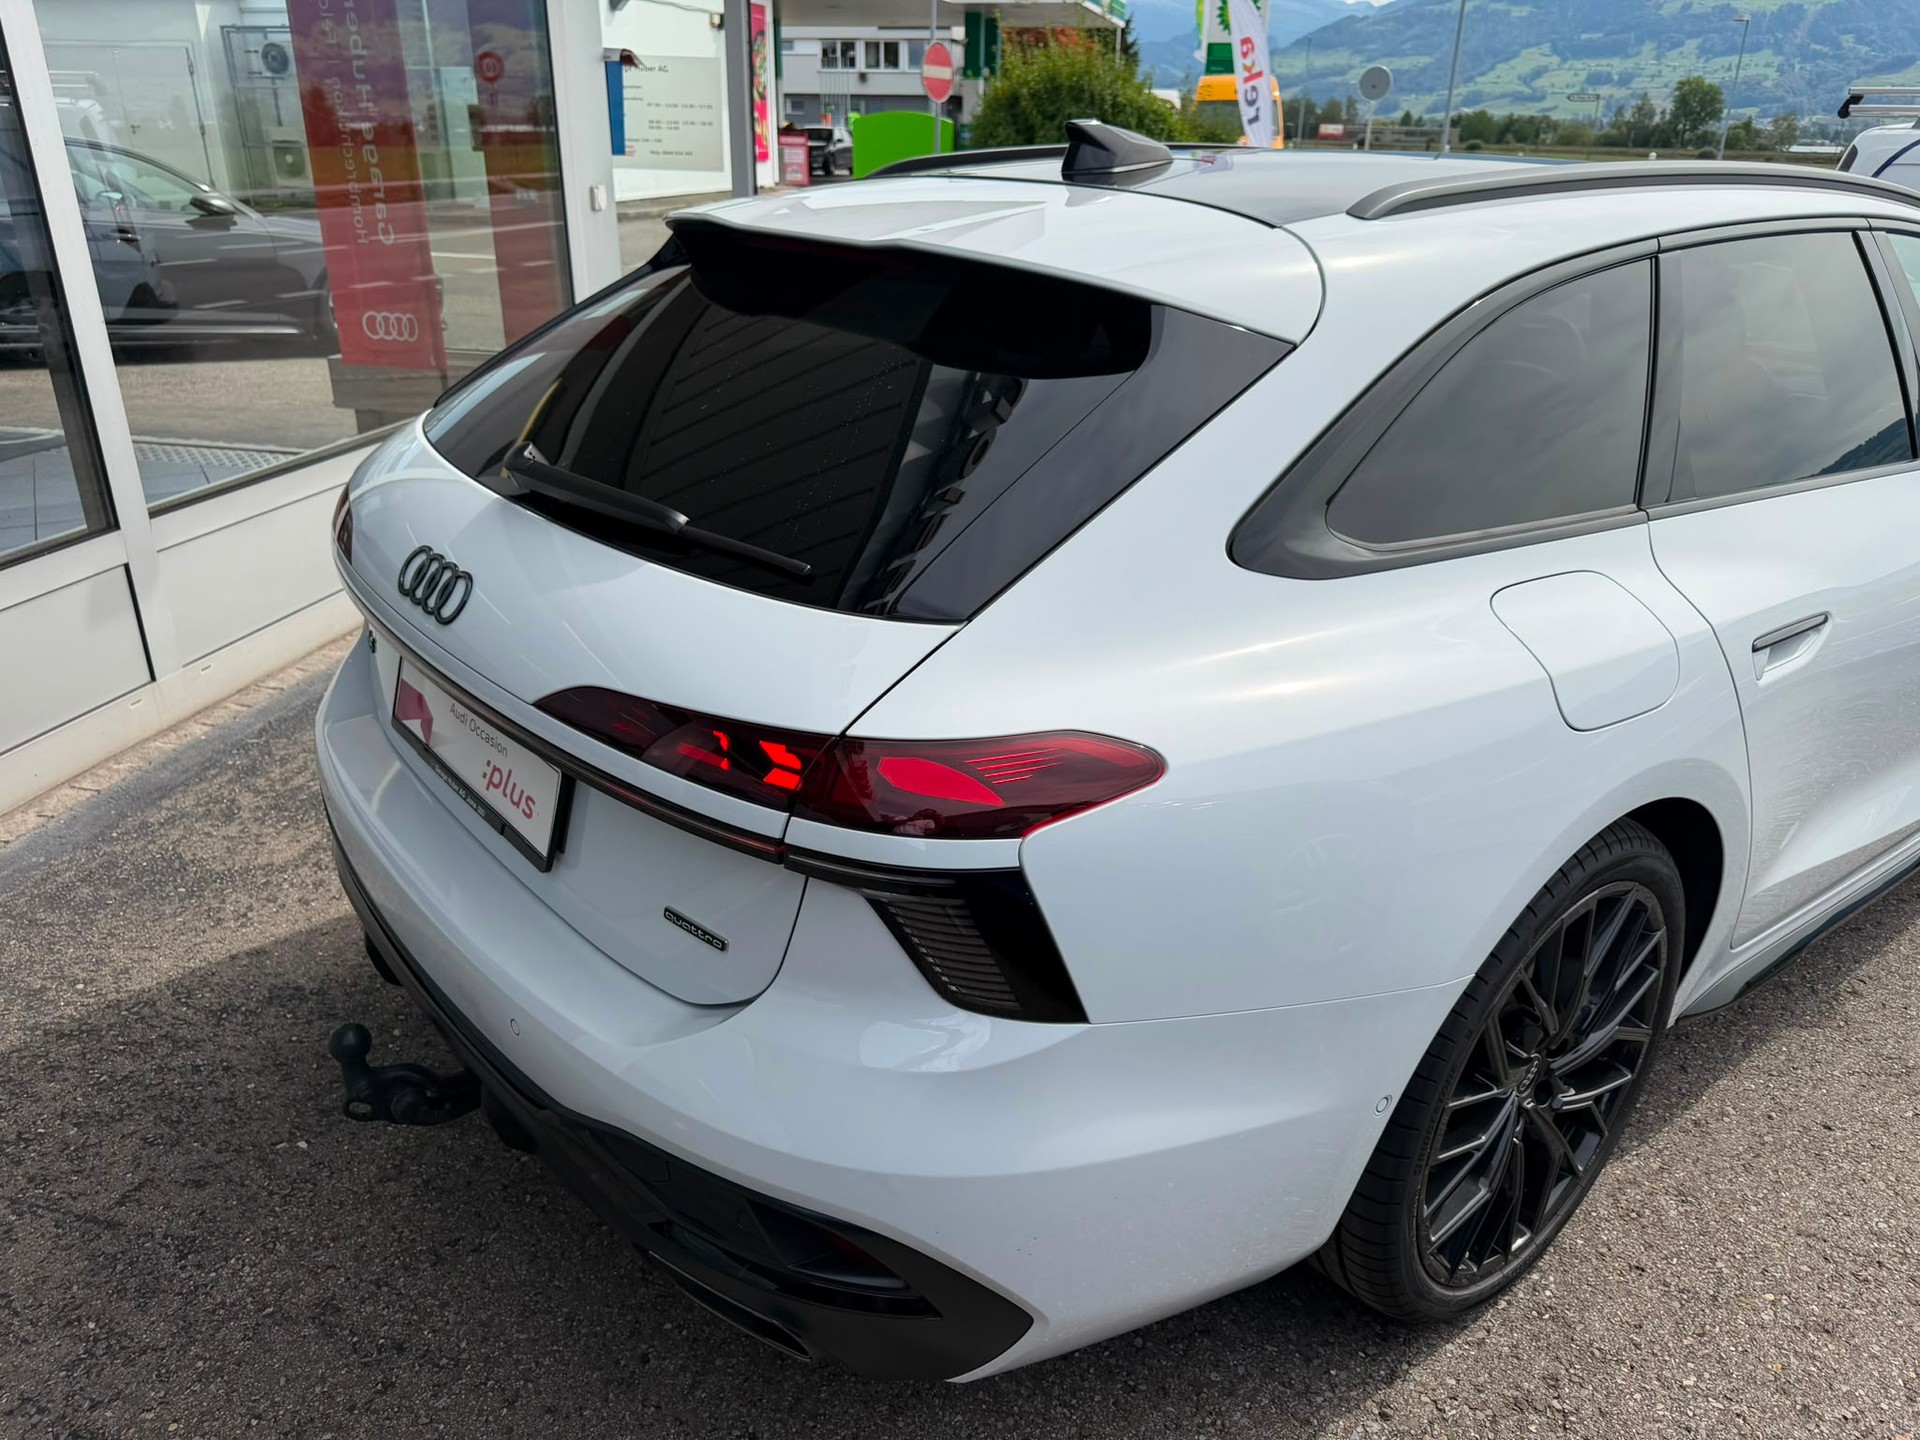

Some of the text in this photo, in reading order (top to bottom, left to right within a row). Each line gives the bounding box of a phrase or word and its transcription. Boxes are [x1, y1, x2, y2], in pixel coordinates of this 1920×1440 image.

[450, 703, 509, 759] Audi Occasion
[665, 911, 722, 949] quattro
